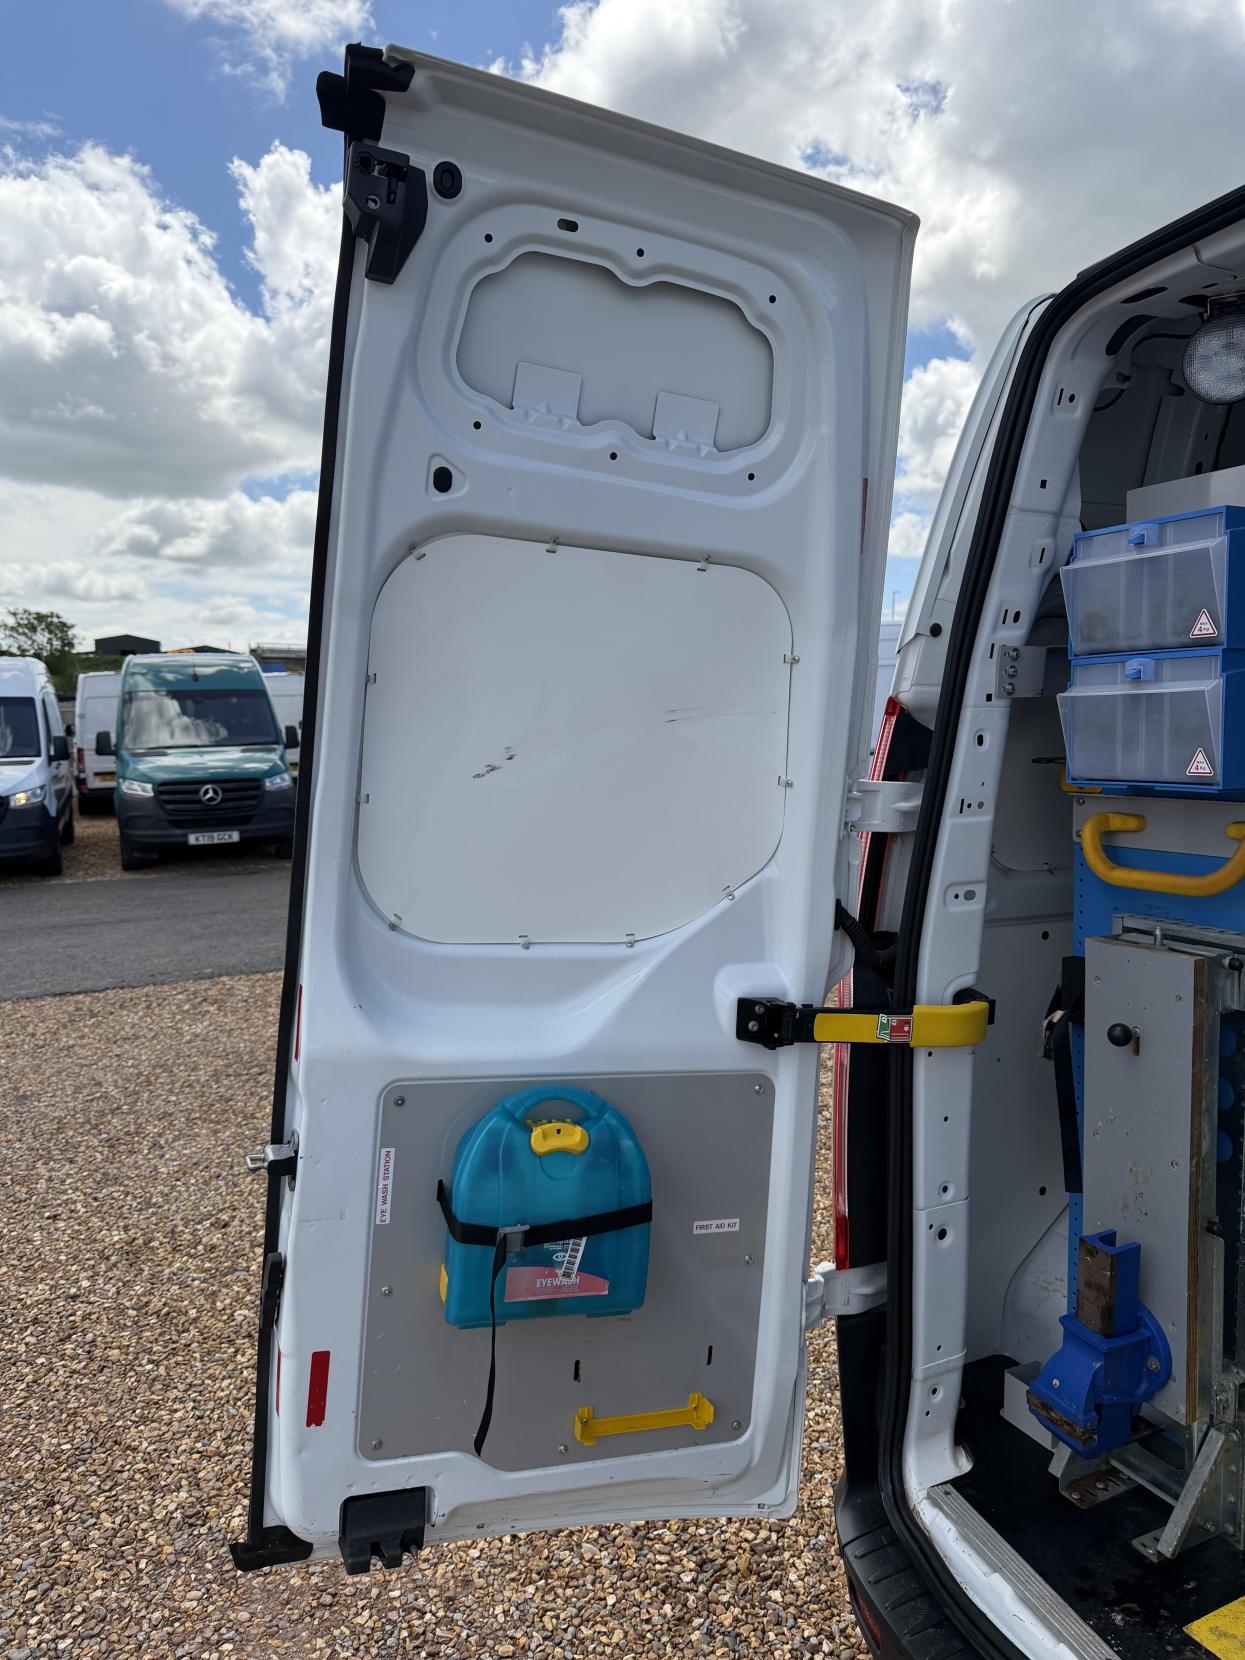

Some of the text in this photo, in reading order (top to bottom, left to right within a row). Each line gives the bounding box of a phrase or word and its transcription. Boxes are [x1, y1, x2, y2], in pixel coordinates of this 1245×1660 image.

[383, 1150, 392, 1181] STATION
[381, 1183, 389, 1206] WASH
[695, 1221, 738, 1231] FIRST AID KIT
